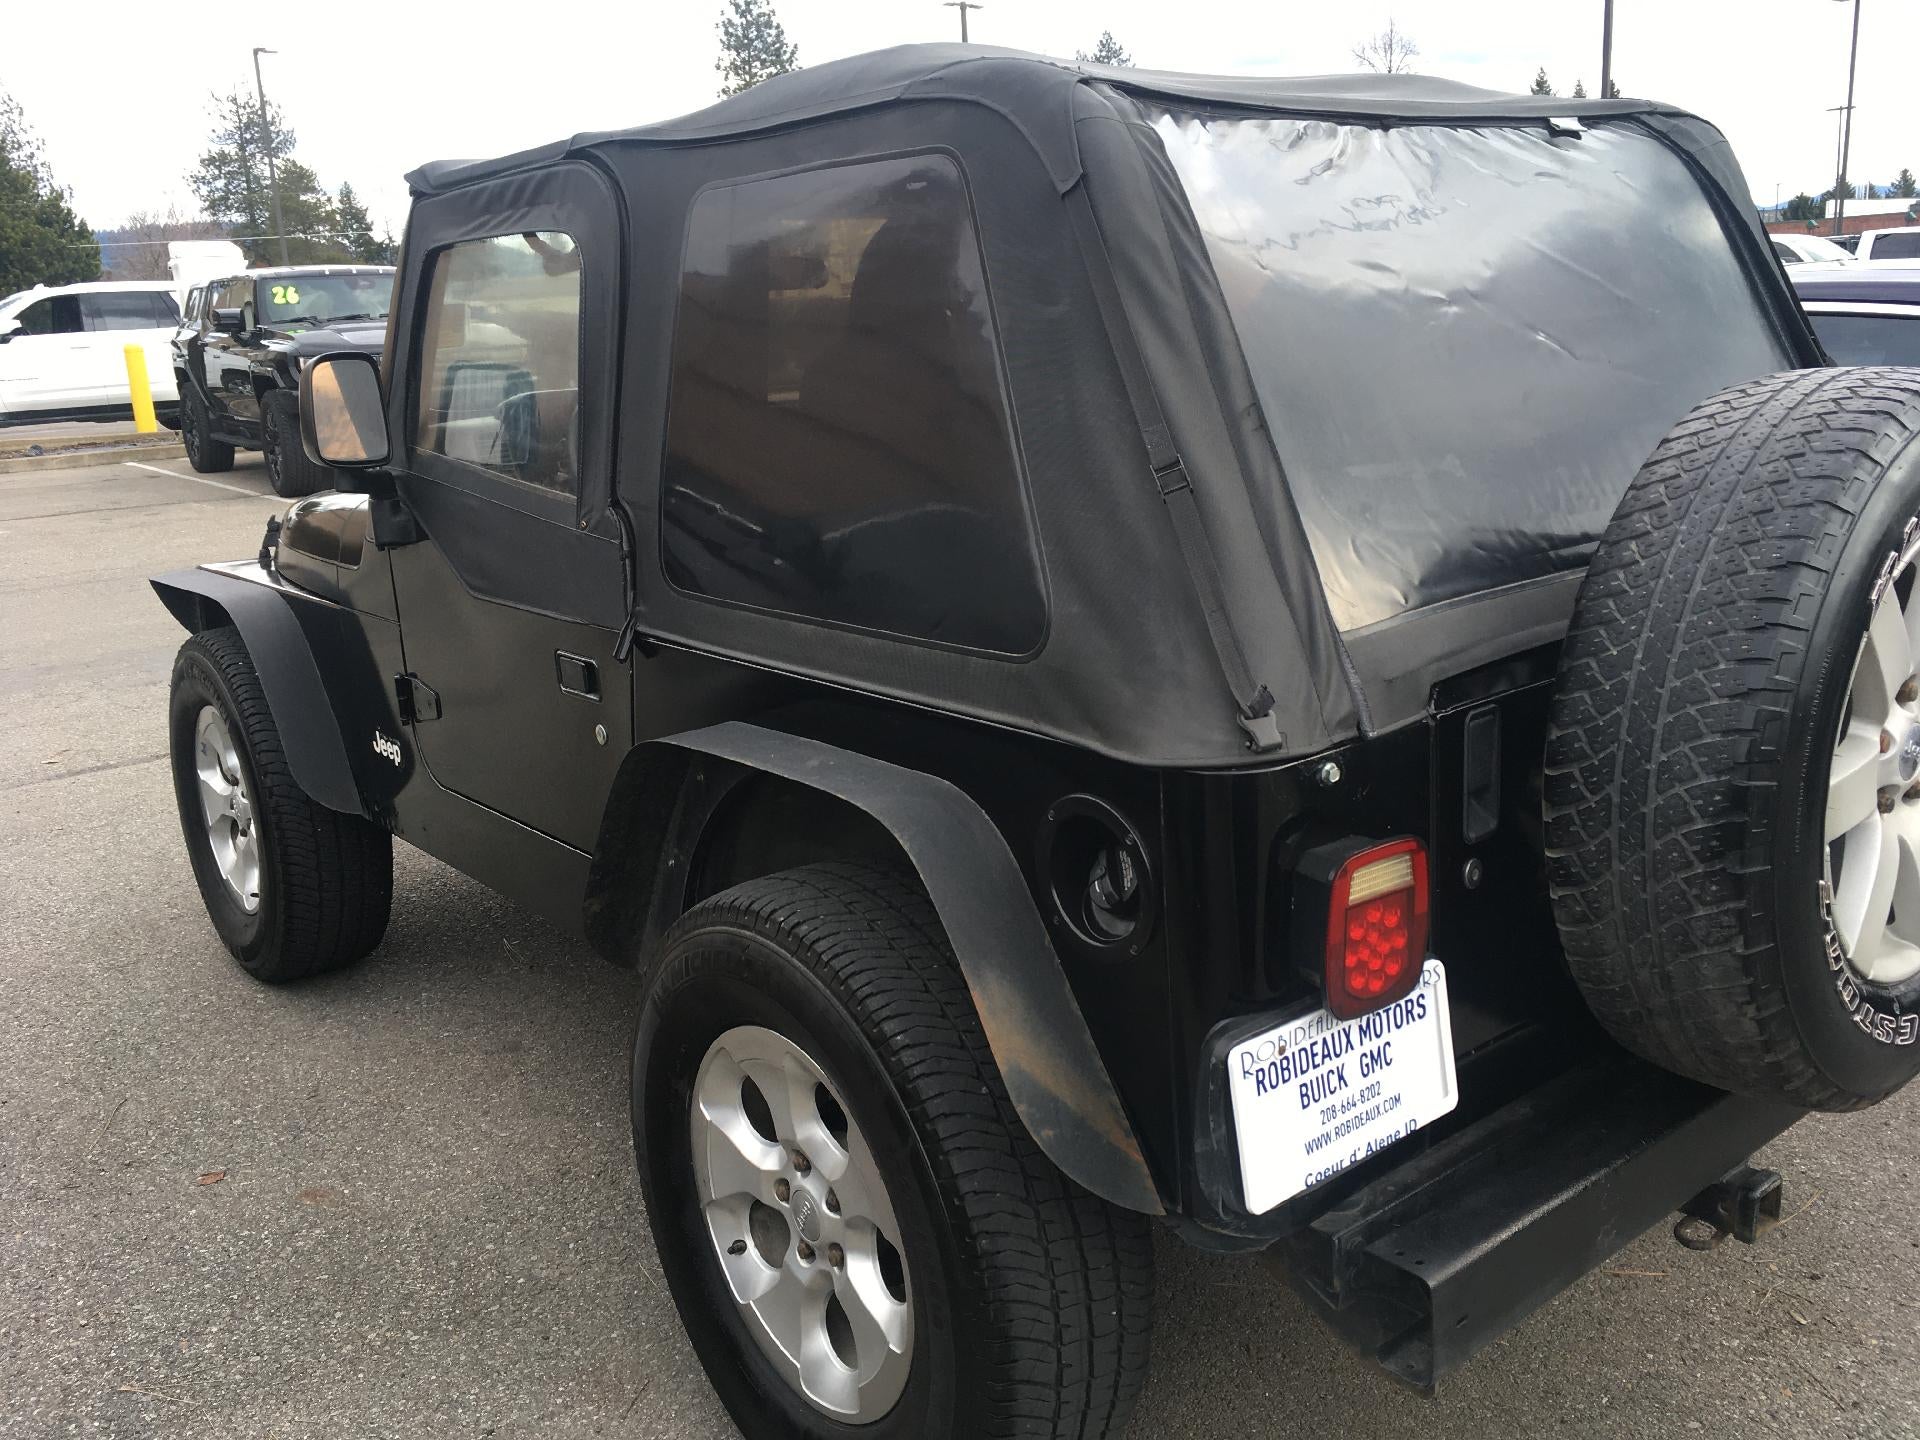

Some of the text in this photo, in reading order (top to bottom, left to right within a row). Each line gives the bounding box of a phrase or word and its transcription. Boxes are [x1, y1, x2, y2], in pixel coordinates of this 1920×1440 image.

[271, 286, 299, 304] 26
[373, 730, 401, 766] Jeep
[1255, 993, 1426, 1096] ROBIDEAUX MOTORS
[1299, 1041, 1393, 1110] BUICK GMC
[1304, 1093, 1402, 1156] WWW.ROBIDEAUX.COM
[1320, 1081, 1381, 1125] 208-664-8202
[1304, 1159, 1345, 1188] Coeur
[1365, 1129, 1401, 1158] Alene
[1404, 1118, 1418, 1136] ID
